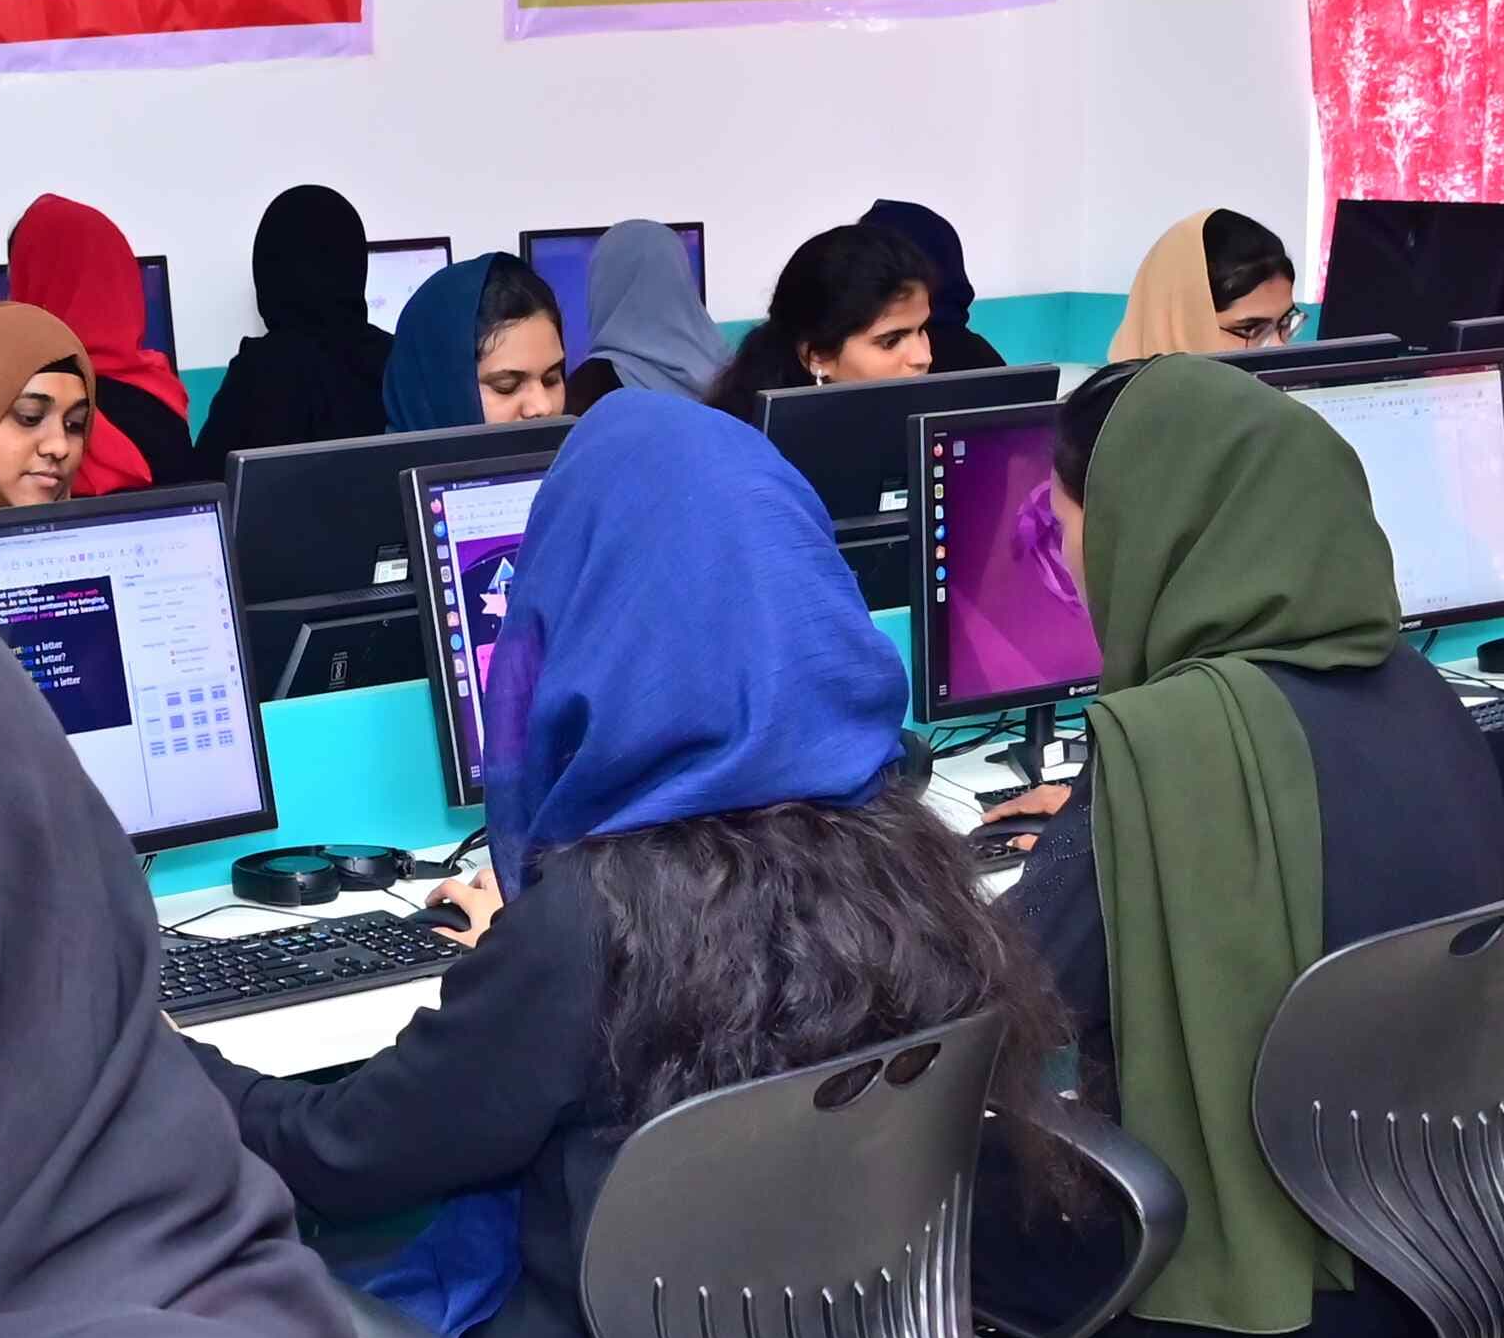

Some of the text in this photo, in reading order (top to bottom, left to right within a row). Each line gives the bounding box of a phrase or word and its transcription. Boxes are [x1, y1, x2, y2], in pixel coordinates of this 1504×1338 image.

[42, 641, 63, 651] letter
[42, 653, 66, 663] letter?
[53, 665, 74, 675] letter
[60, 676, 81, 686] letter
